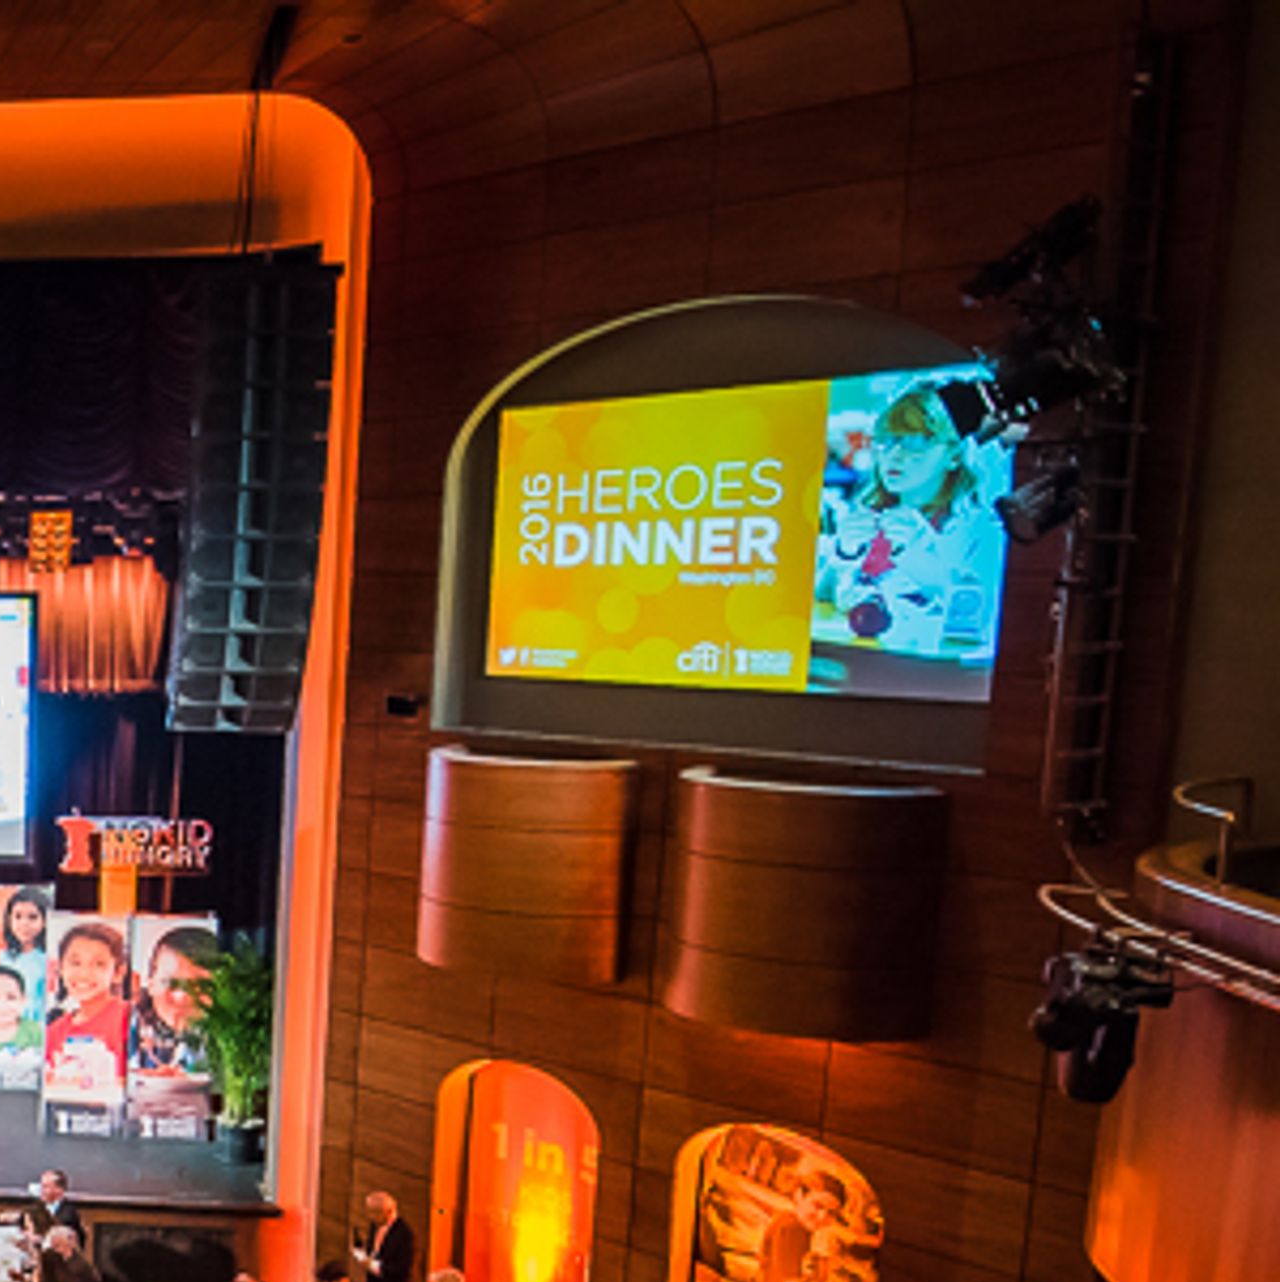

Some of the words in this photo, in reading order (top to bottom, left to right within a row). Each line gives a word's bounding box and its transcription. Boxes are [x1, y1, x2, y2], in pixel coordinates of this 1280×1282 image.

[555, 458, 784, 515] HEROES
[520, 471, 553, 565] 2016
[553, 516, 781, 567] DINNER
[492, 1122, 509, 1159] 1
[523, 1126, 565, 1176] in
